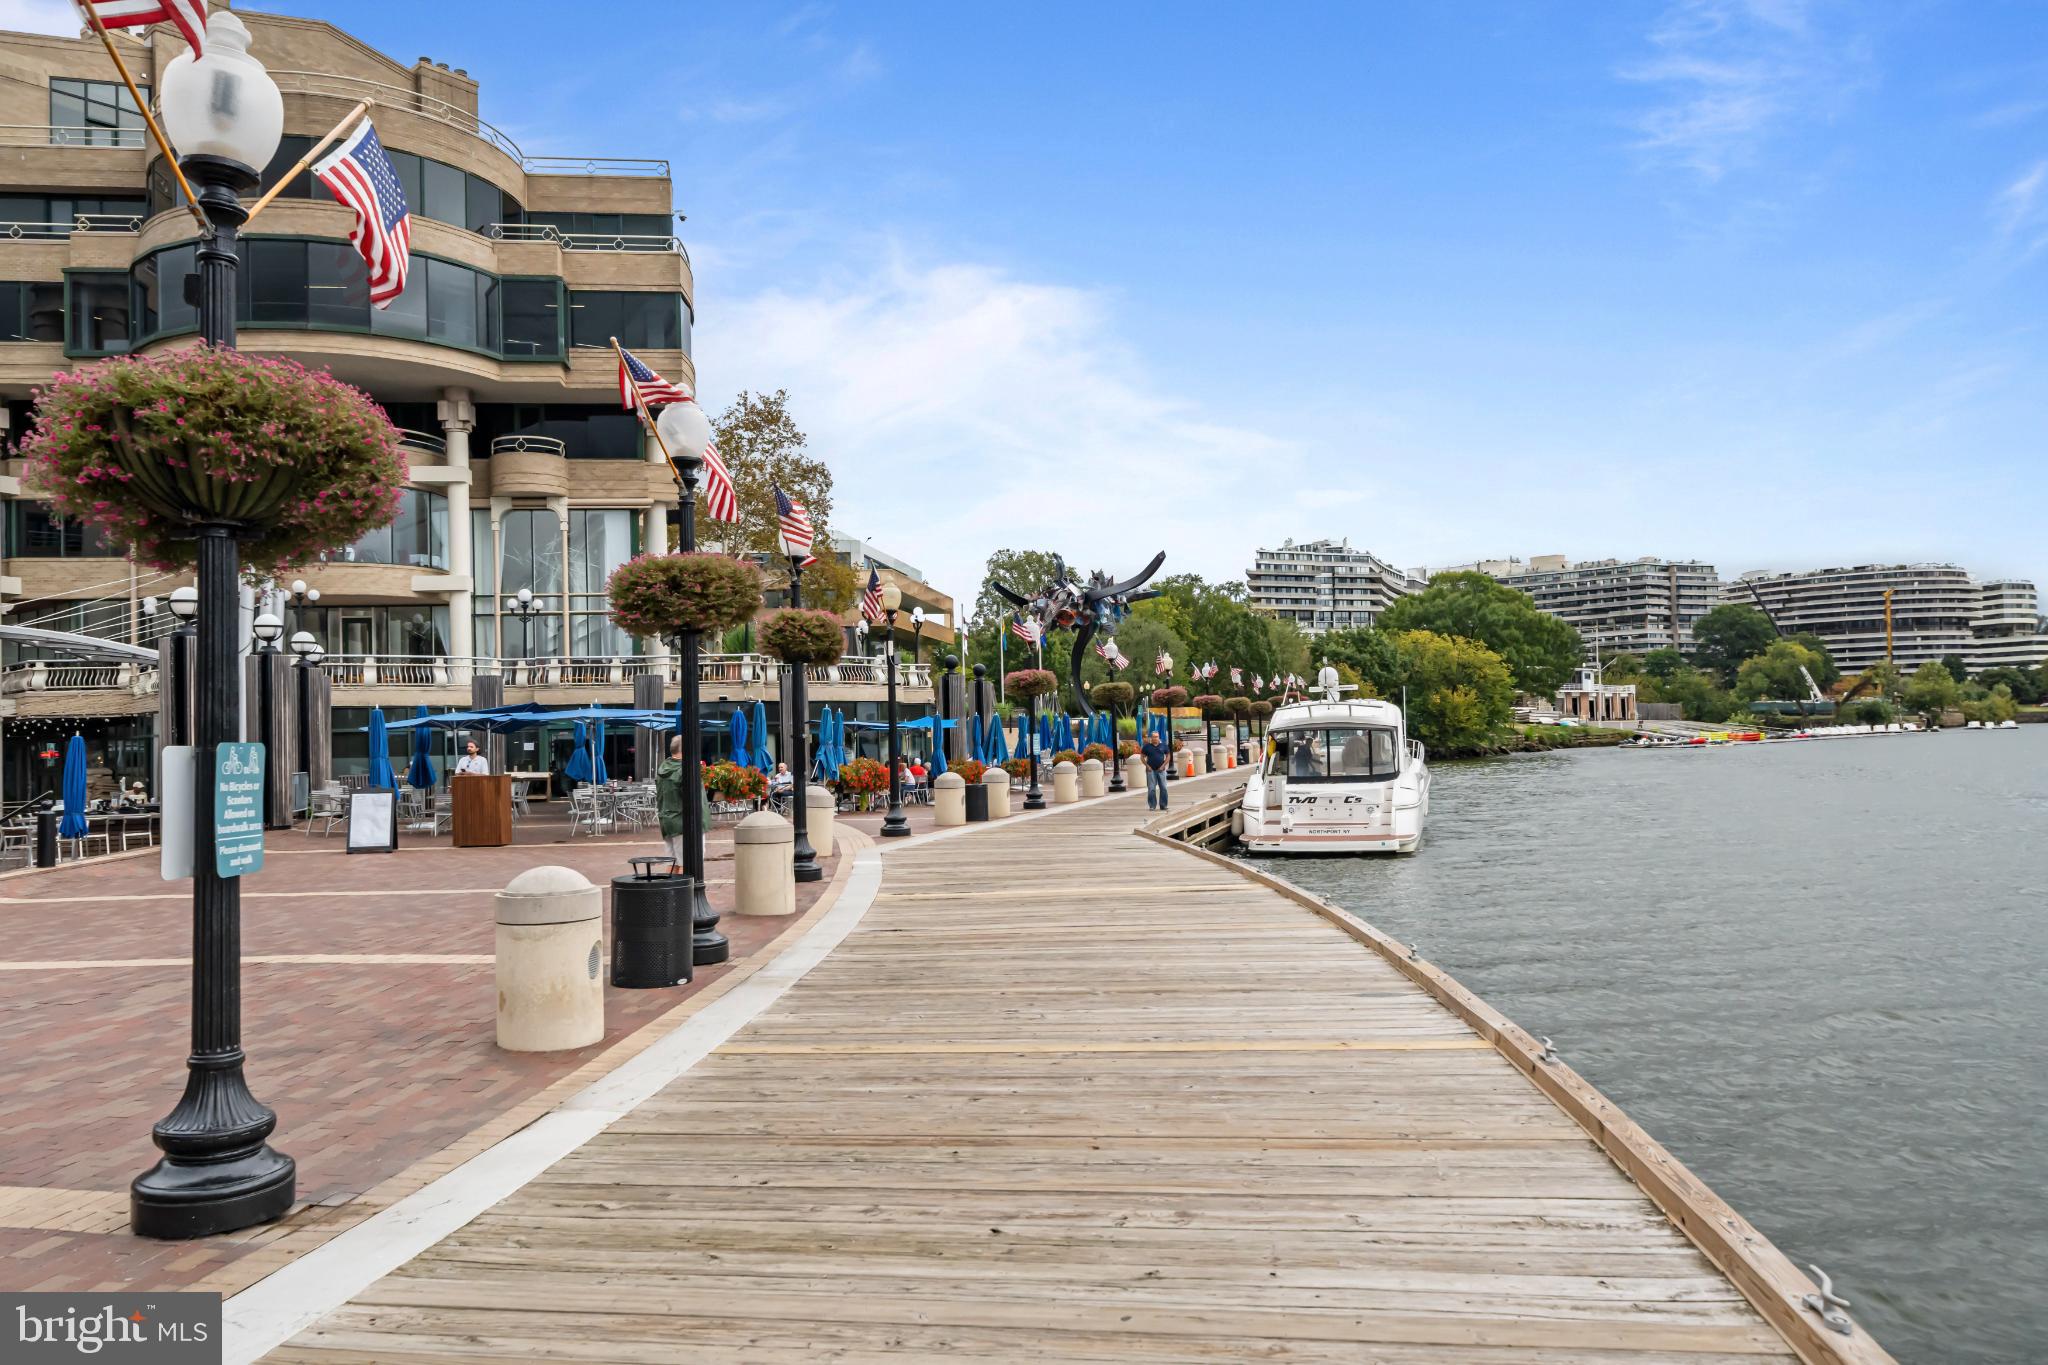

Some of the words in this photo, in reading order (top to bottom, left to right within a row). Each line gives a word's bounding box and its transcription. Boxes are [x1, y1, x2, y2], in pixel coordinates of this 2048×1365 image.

[229, 781, 253, 794] Bicycles
[226, 795, 253, 805] Scooters
[224, 807, 248, 819] Allowed
[217, 821, 248, 834] boardwalk
[219, 845, 238, 856] Please
[238, 841, 262, 853] dismount
